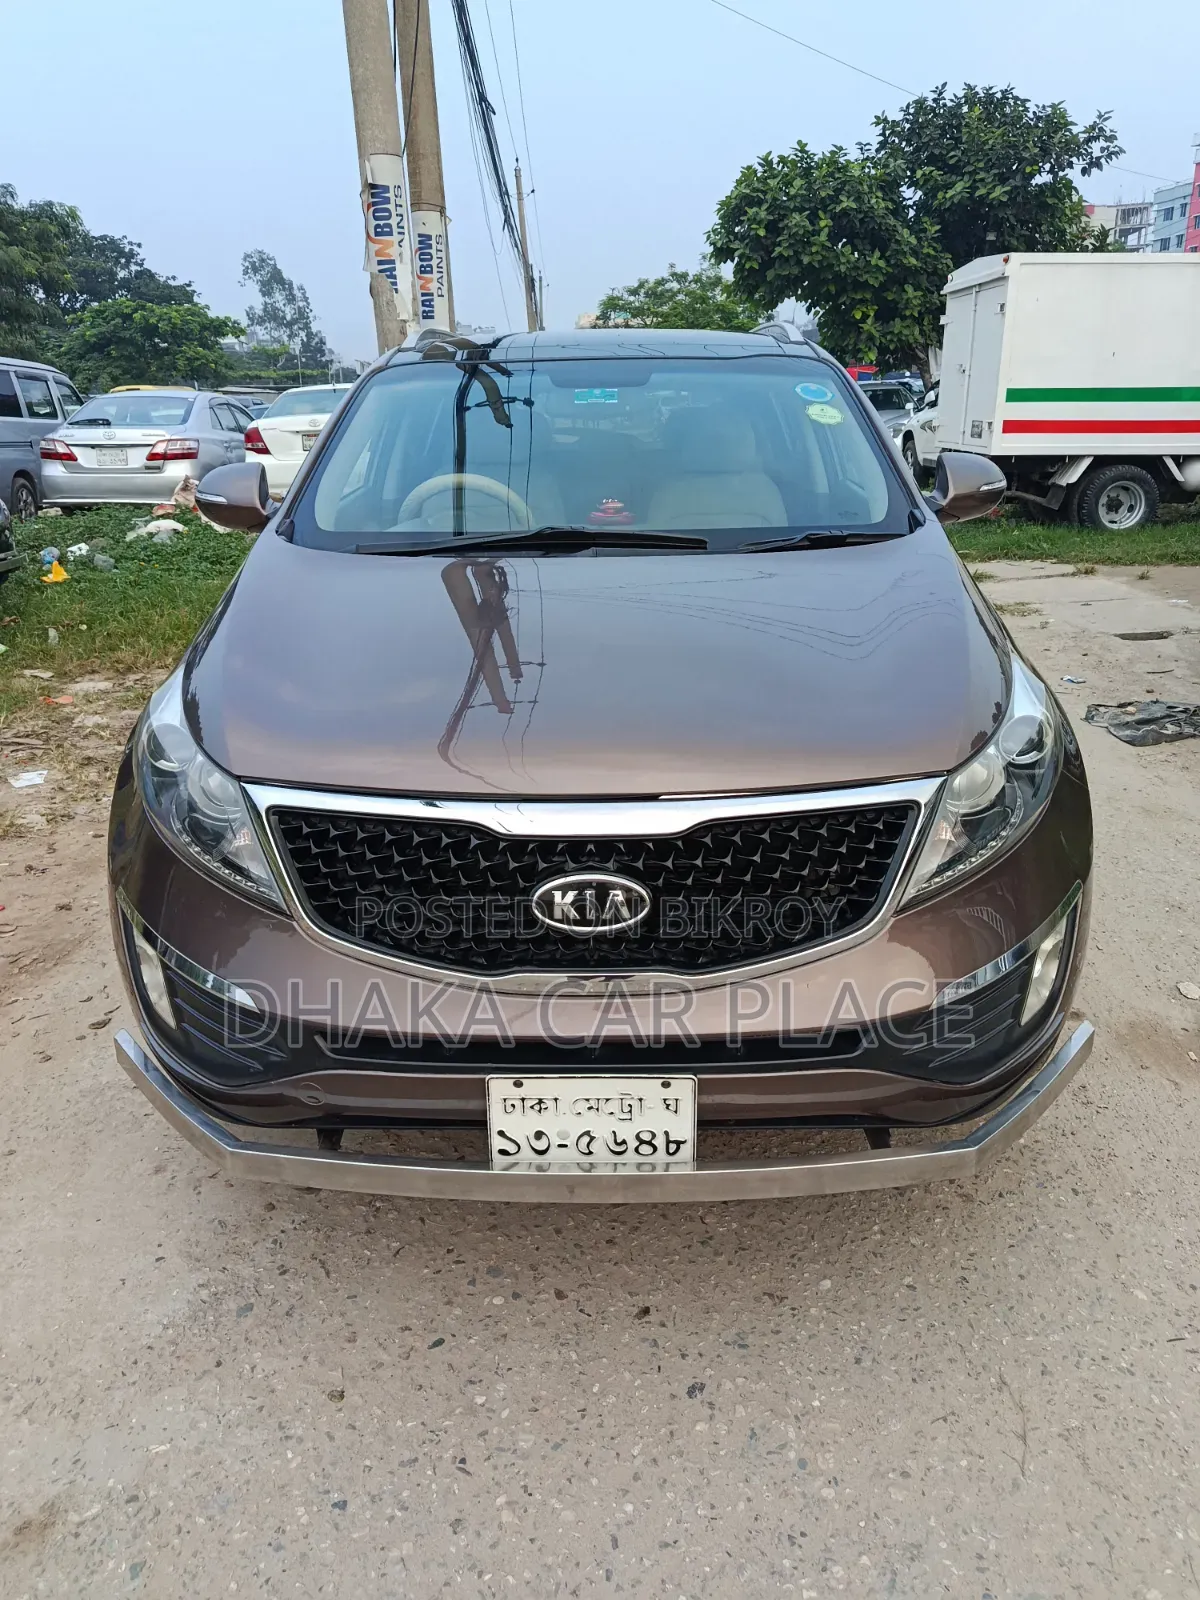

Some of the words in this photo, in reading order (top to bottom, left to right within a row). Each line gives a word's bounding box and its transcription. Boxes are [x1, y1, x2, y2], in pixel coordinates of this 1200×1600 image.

[414, 233, 435, 320] RAINBOW
[435, 234, 445, 298] PAINTS
[551, 889, 632, 920] KIA
[501, 1096, 560, 1116] ঢাকা
[496, 1129, 688, 1156] ১৩-৫৬৪৮
